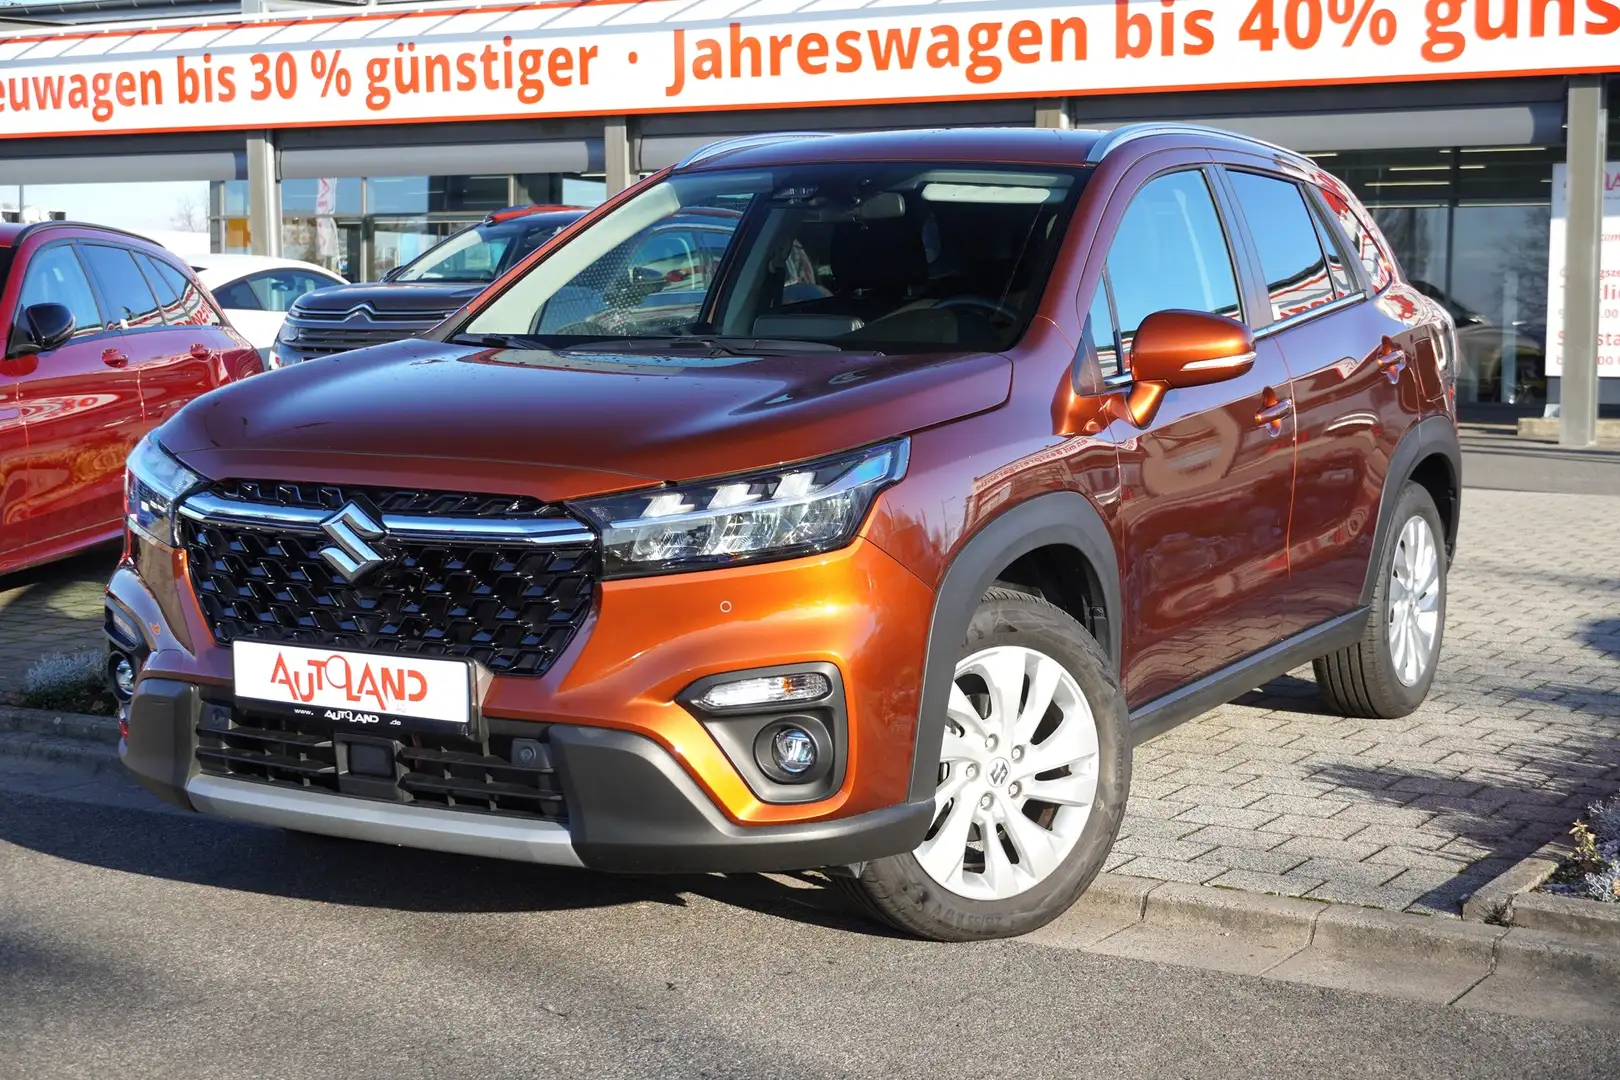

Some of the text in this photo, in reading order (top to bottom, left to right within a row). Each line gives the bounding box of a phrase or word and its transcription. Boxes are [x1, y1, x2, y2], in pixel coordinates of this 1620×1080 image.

[0, 69, 163, 122] uwagen
[176, 54, 236, 105] bis
[249, 52, 298, 100] 30
[311, 49, 352, 98] %
[365, 36, 599, 111] günstiger
[665, 22, 1088, 96] Jahreswagen
[1115, 0, 1215, 59] bis
[1238, 0, 1398, 51] 40%
[270, 651, 428, 711] AUTOLAND
[294, 708, 314, 716] www.
[324, 709, 380, 724] AUTOLAND
